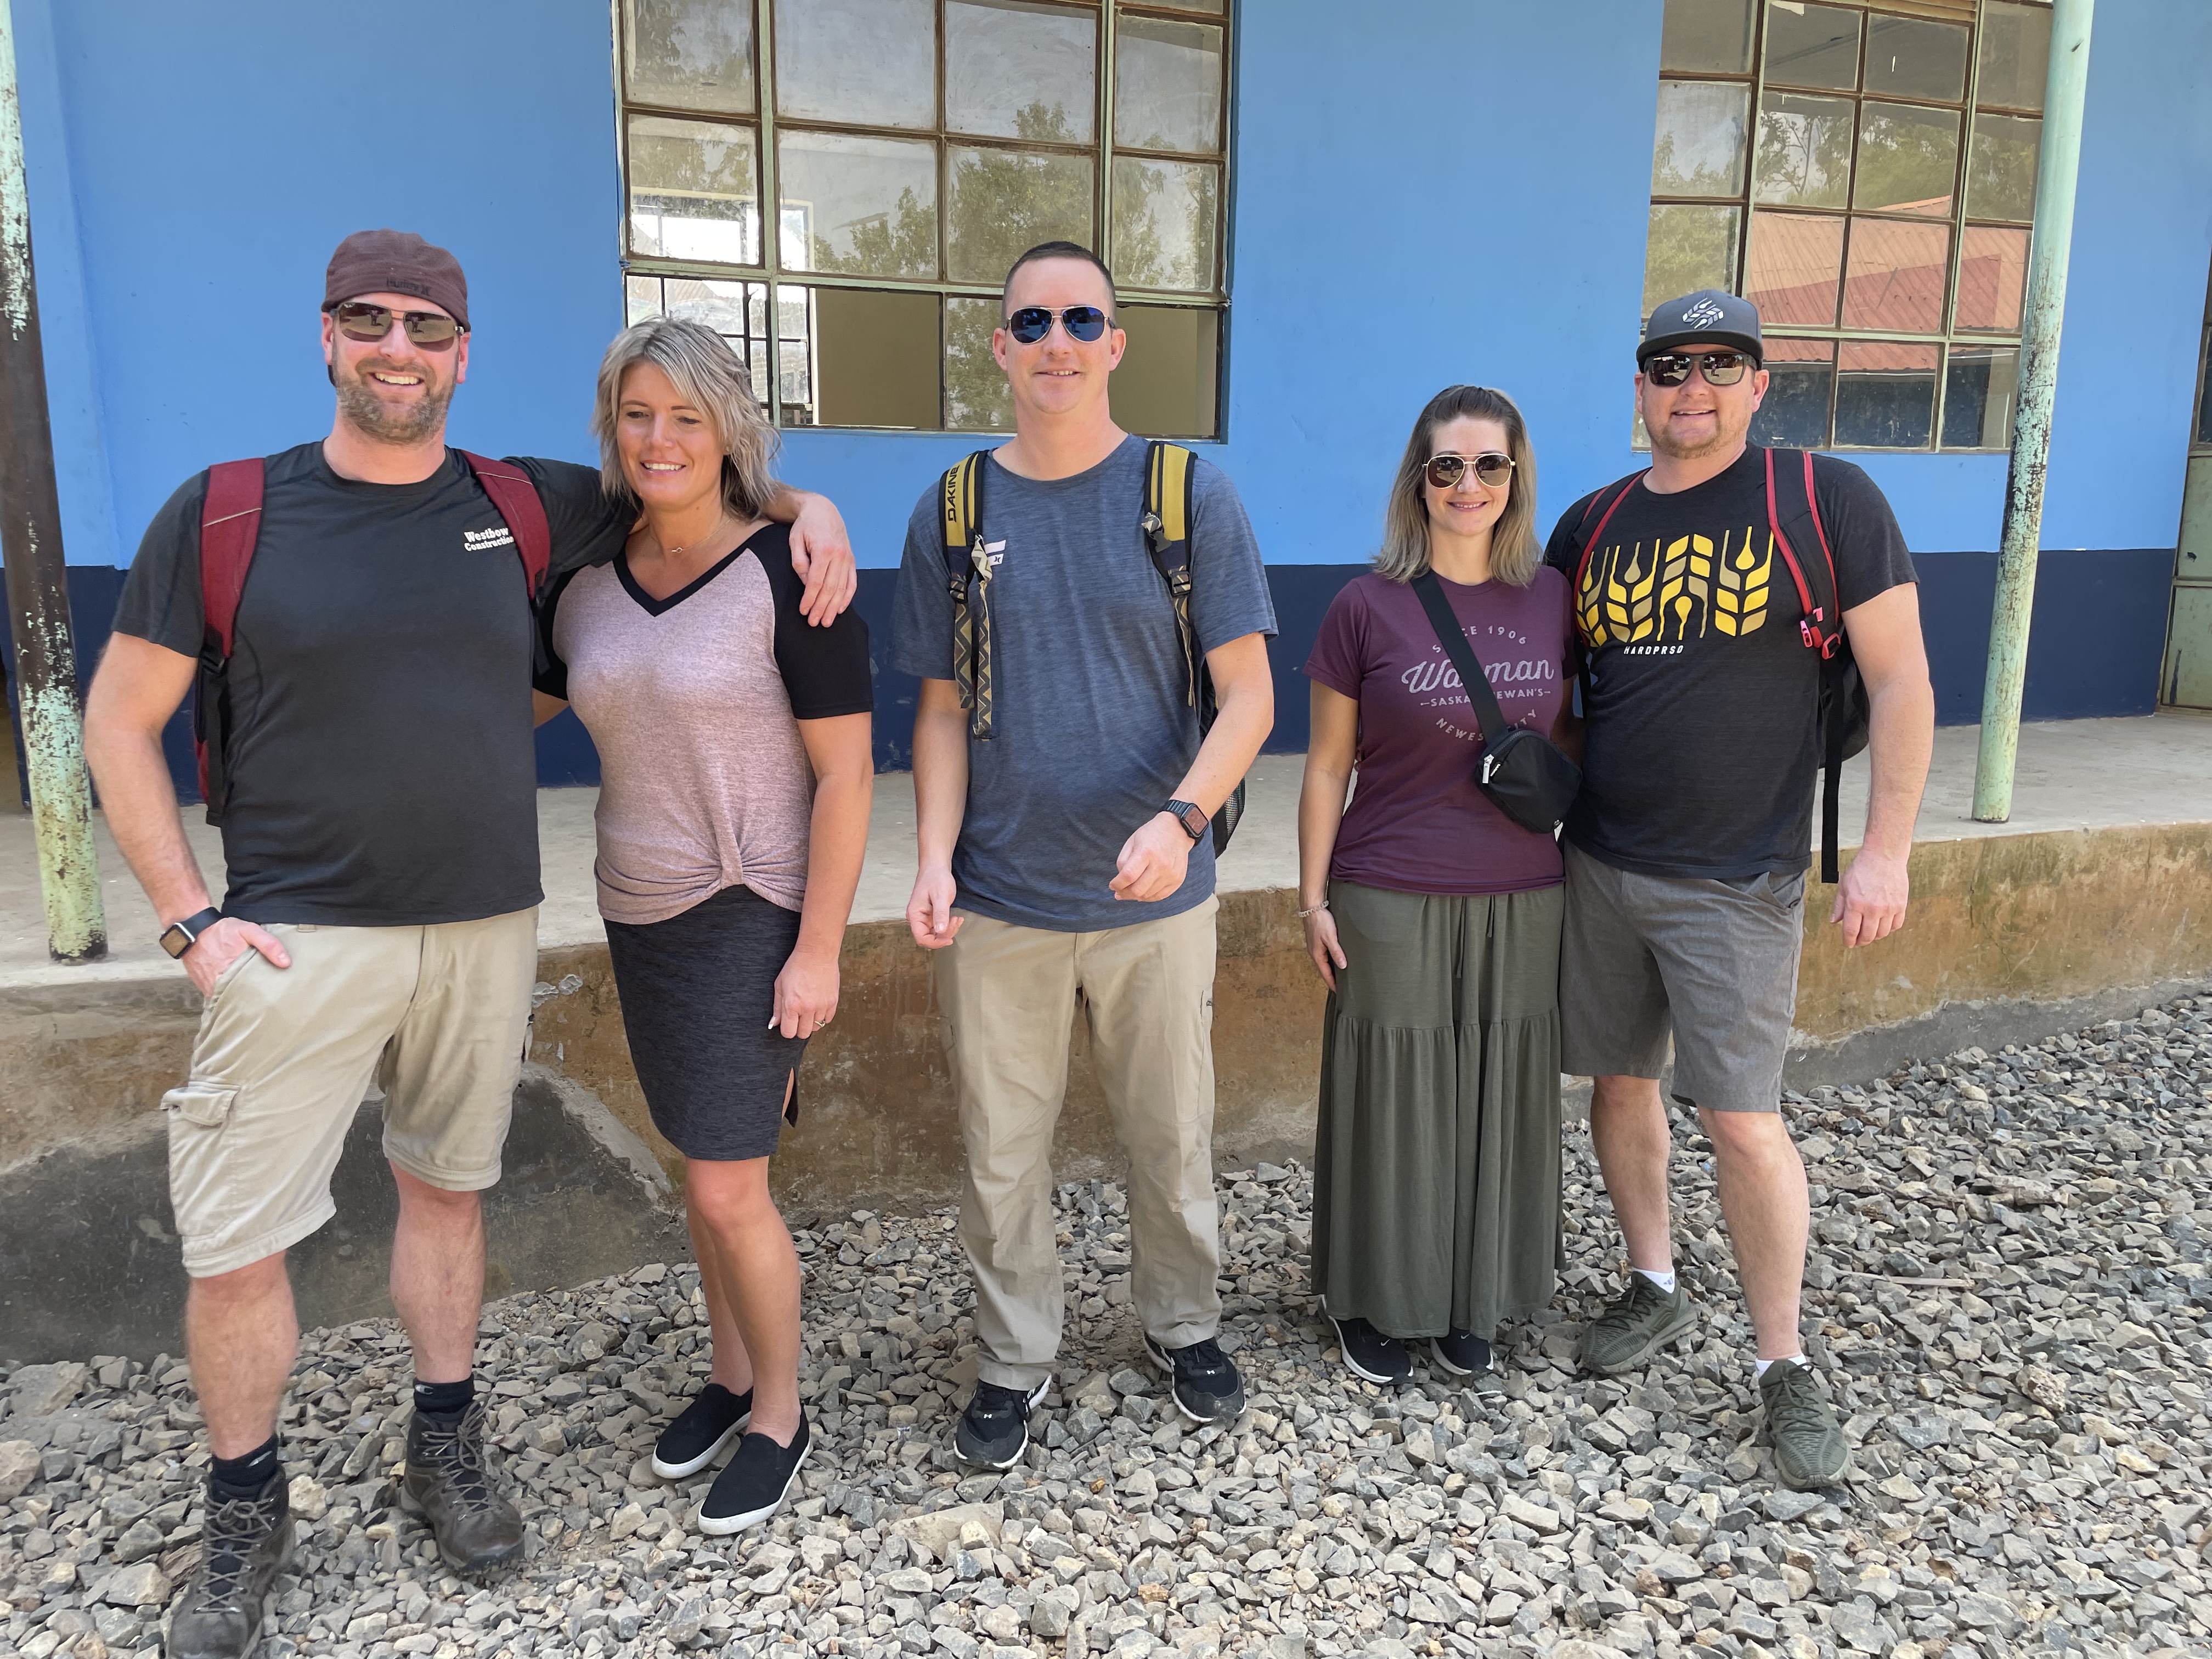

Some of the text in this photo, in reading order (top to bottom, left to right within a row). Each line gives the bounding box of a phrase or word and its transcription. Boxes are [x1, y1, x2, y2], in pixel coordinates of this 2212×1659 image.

[947, 465, 960, 523] DAKINE
[464, 528, 509, 542] Westbow
[464, 535, 515, 551] Construction
[1488, 625, 1527, 645] 1906
[1401, 658, 1555, 693] Waman
[1430, 688, 1544, 707] SASKAEWAN'S
[1436, 709, 1537, 741] NEWES ITY
